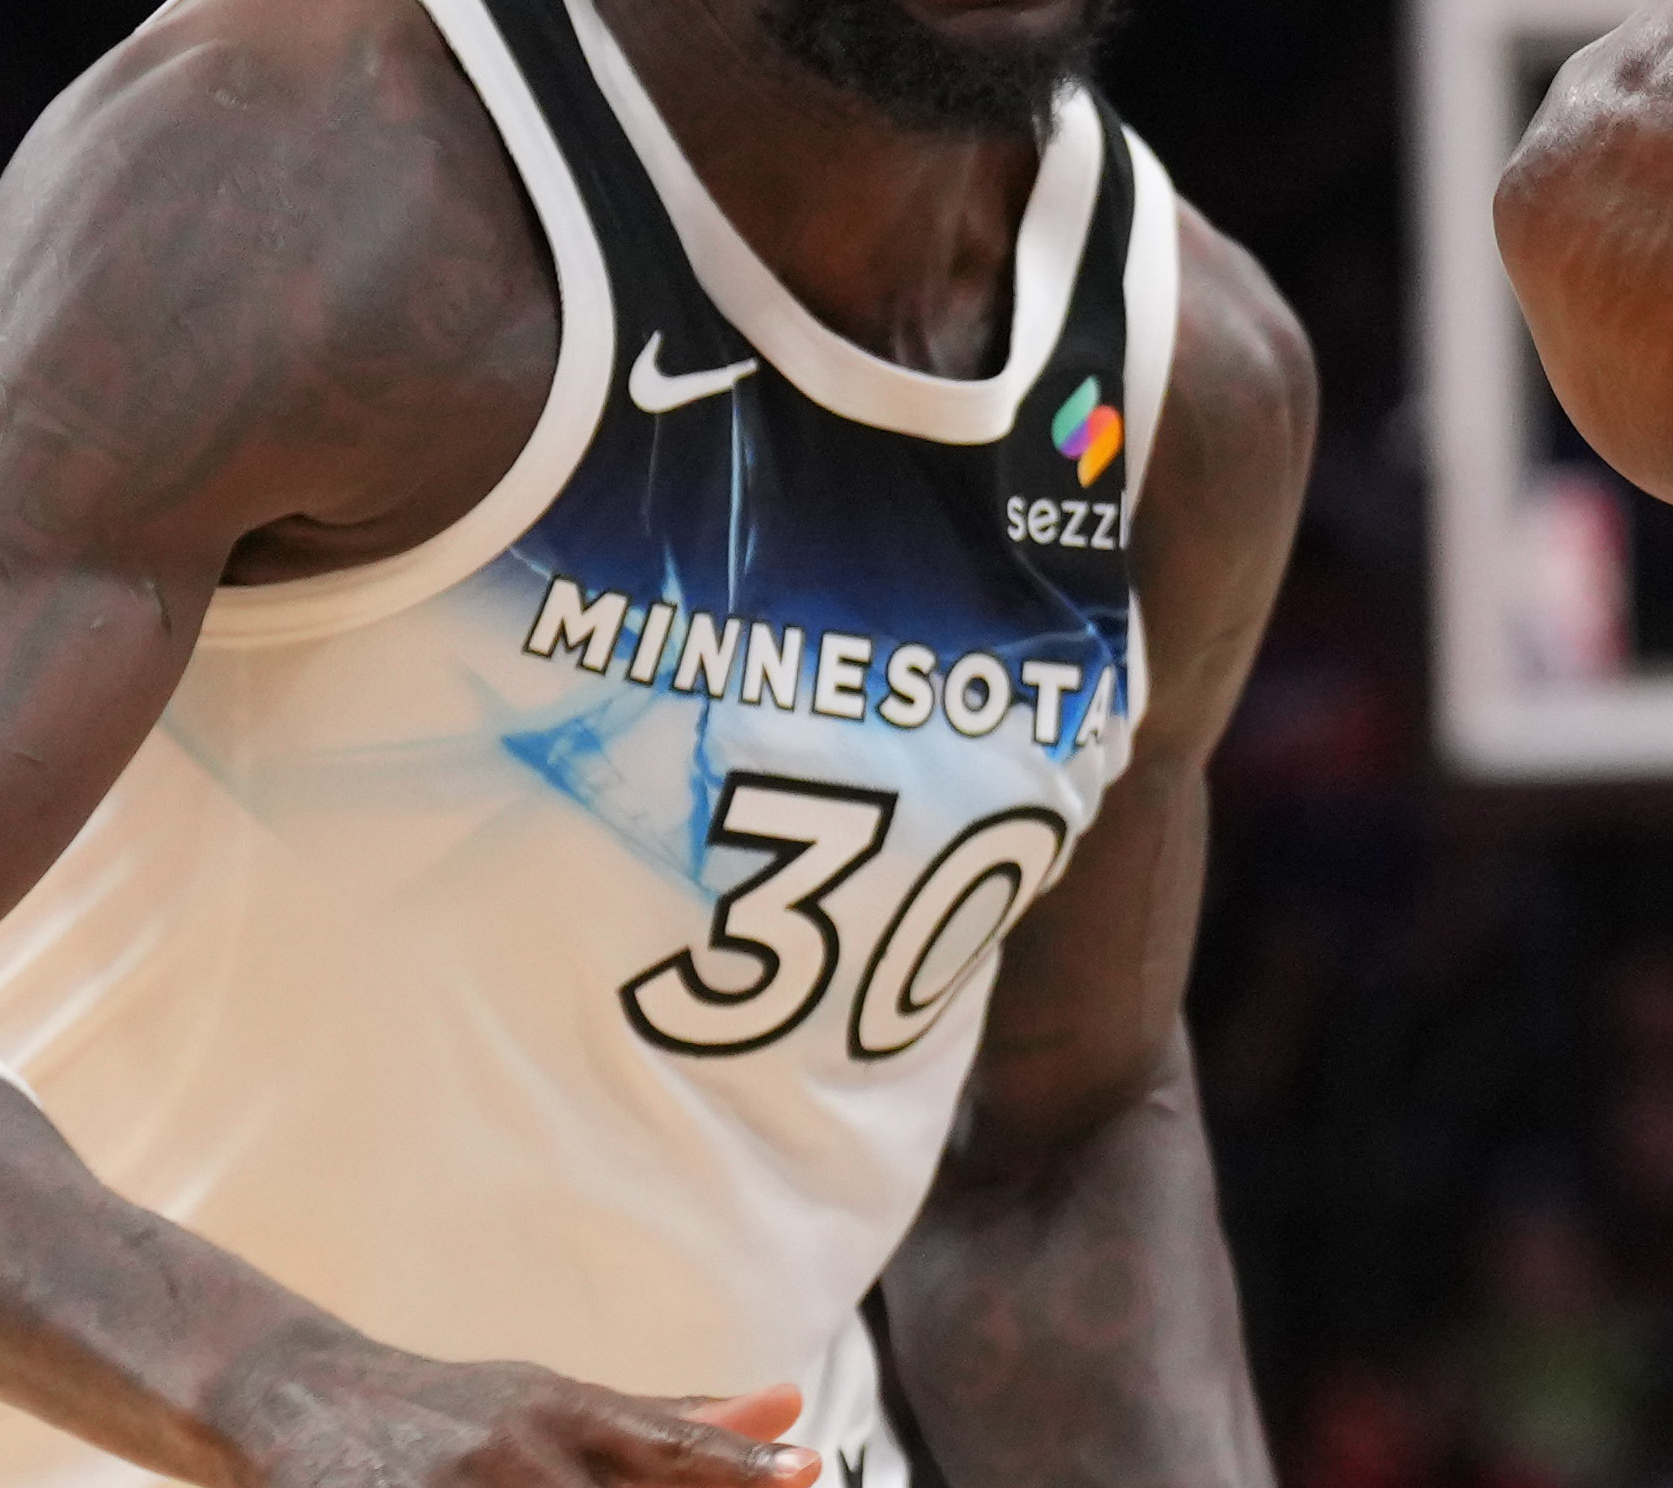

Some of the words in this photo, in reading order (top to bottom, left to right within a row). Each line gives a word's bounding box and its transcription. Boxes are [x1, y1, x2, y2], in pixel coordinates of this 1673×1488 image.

[1006, 489, 1128, 550] sezzl
[523, 573, 1117, 747] MINNESOTA
[618, 767, 1069, 1064] 30
